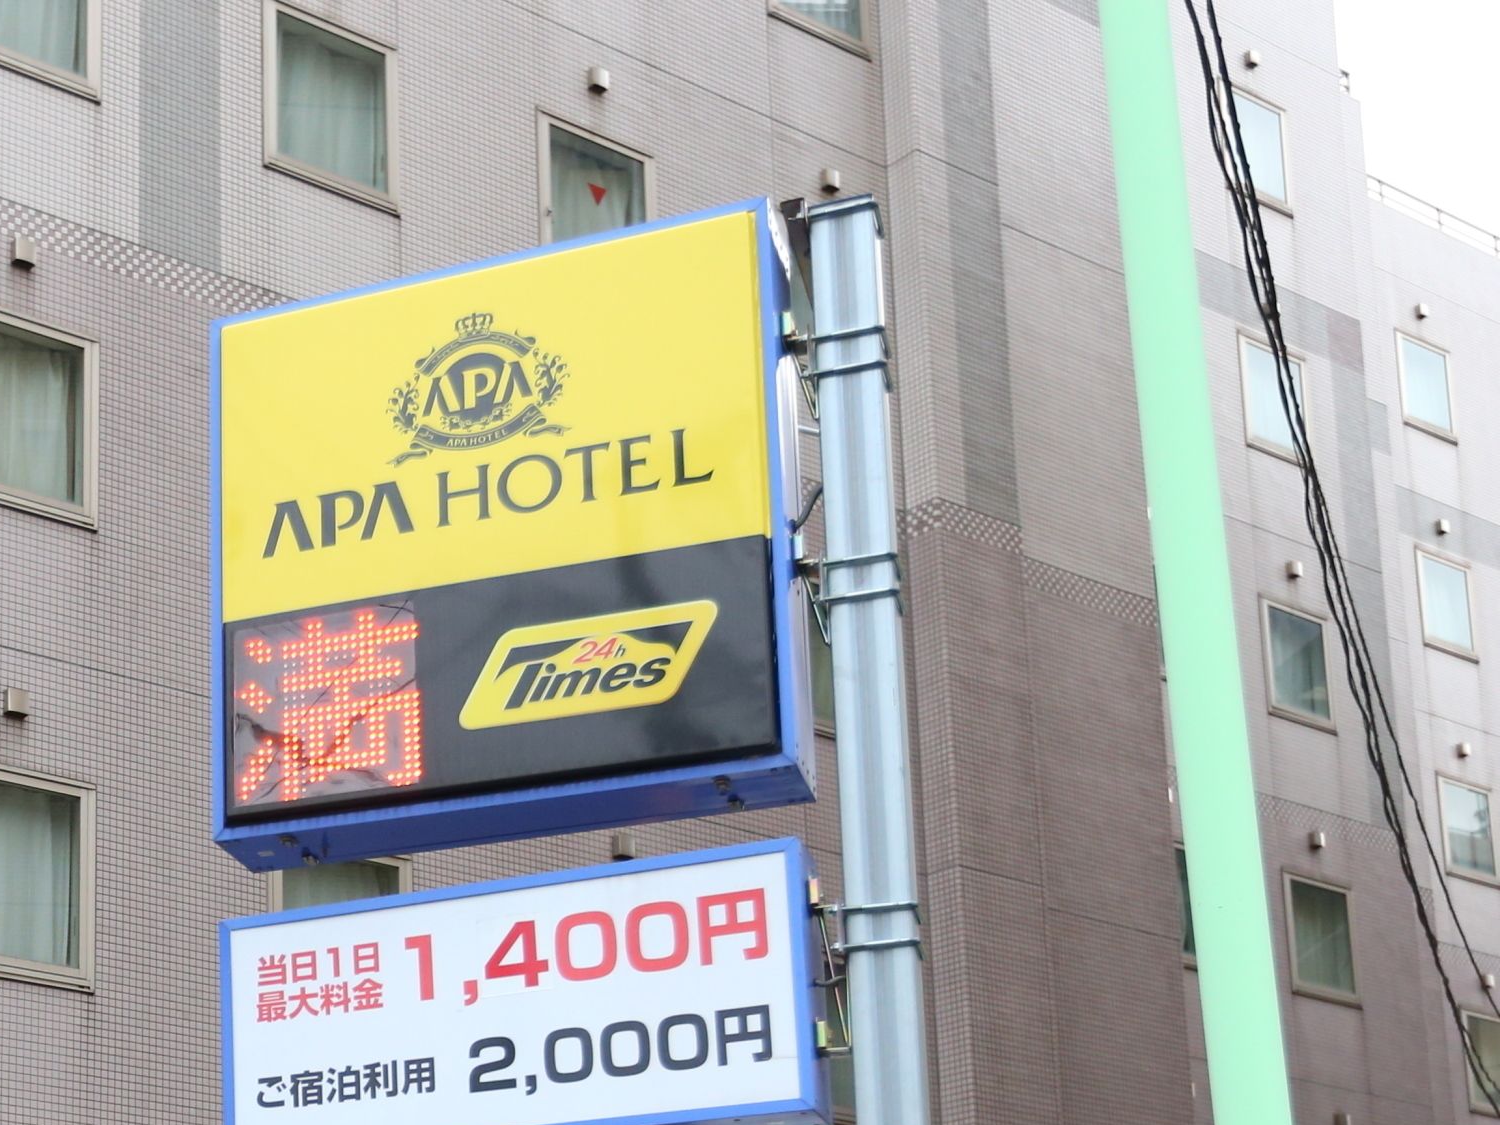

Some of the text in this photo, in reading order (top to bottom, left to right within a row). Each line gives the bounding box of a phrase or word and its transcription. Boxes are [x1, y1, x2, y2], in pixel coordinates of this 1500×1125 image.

[422, 360, 533, 418] APA
[446, 428, 509, 447] APA HOTEL
[262, 428, 715, 559] APA HOTEL
[573, 636, 626, 665] 24h
[235, 608, 422, 802] 満
[503, 654, 672, 711] Times
[257, 887, 769, 1007] 当日1日 1,400円
[255, 977, 384, 1024] 最大料金
[256, 1003, 773, 1110] ご宿泊利用 2,000円
